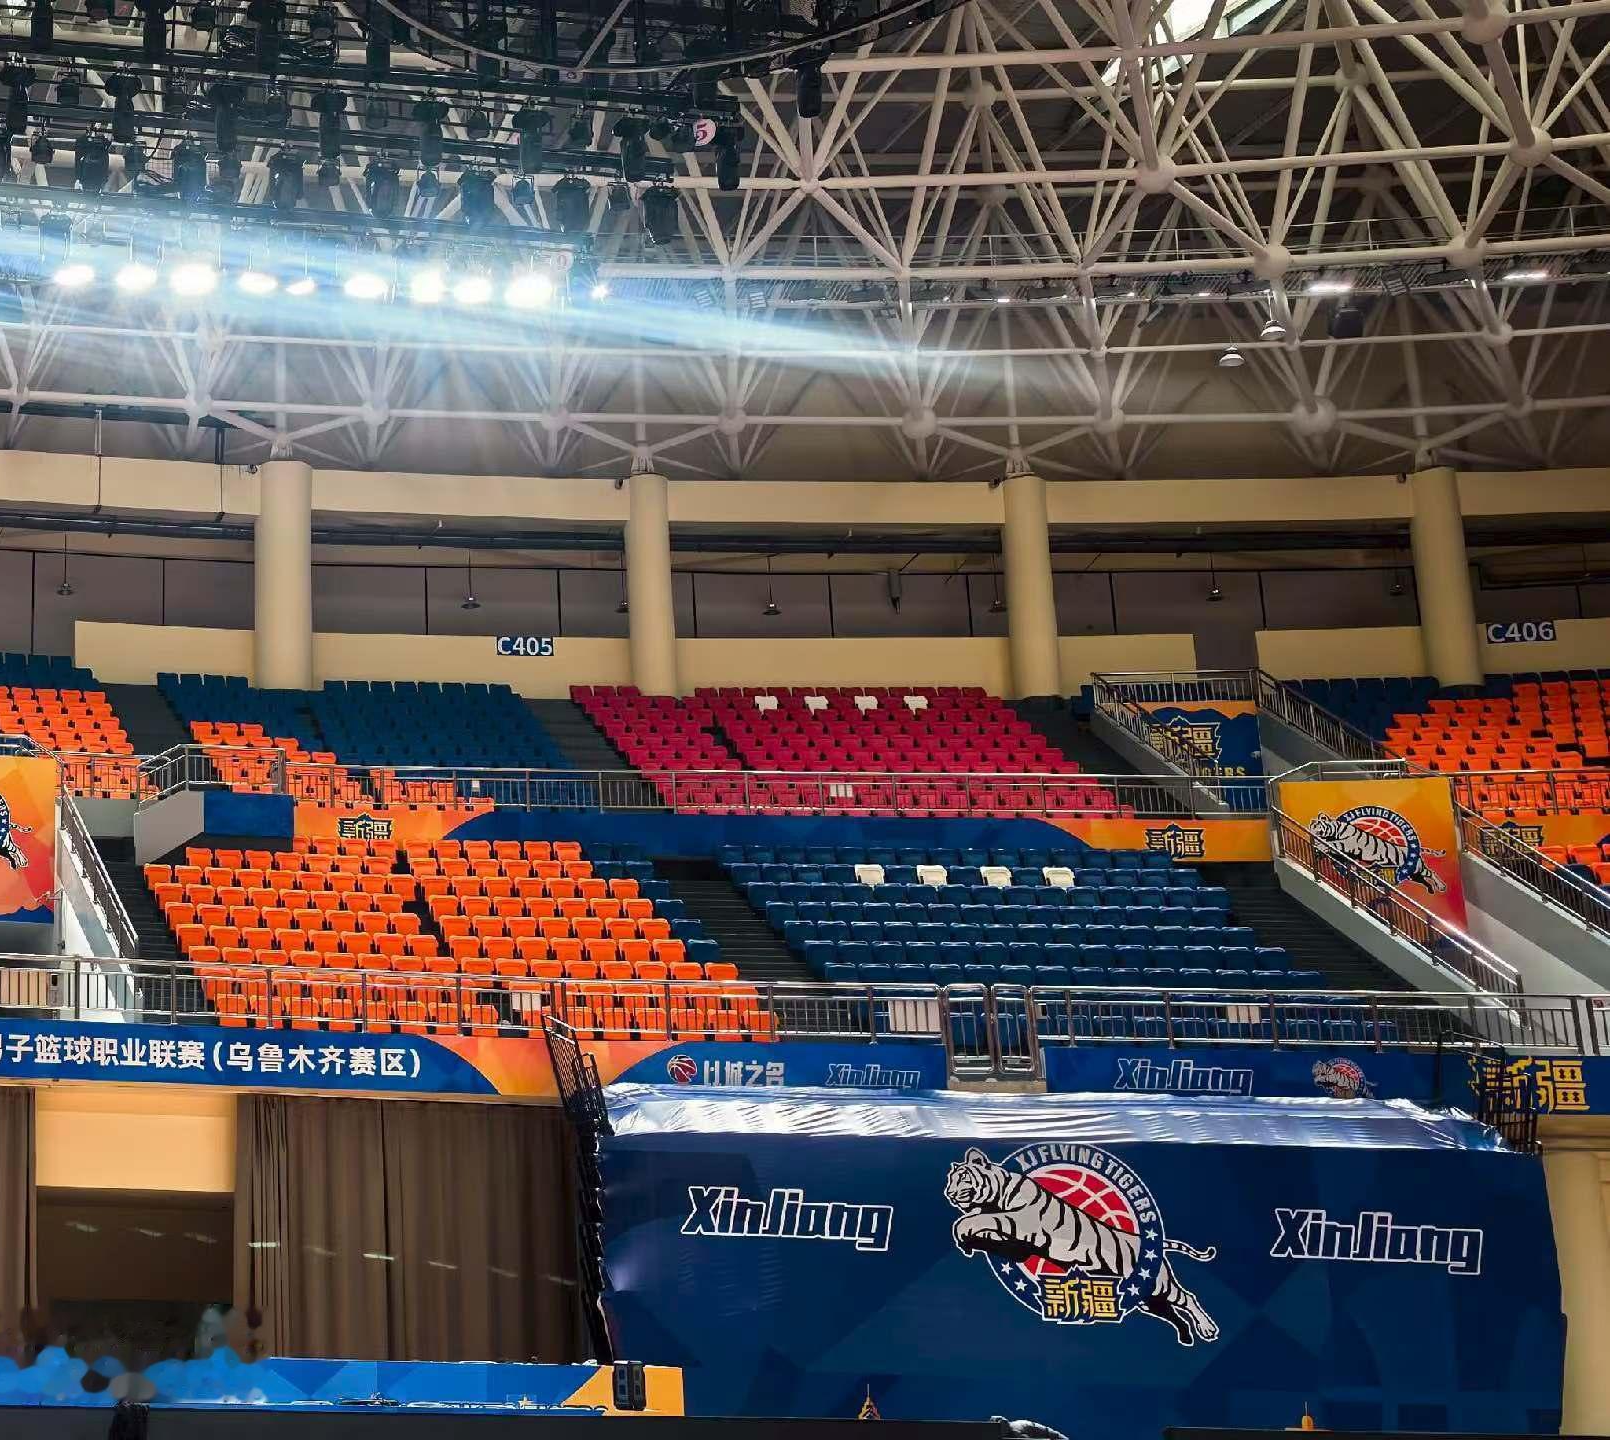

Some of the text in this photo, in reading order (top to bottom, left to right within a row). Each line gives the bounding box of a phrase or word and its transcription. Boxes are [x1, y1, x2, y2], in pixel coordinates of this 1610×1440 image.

[695, 122, 708, 141] 5
[497, 636, 553, 656] C405
[1487, 621, 1554, 642] C406
[703, 1060, 785, 1087] 以城之名
[824, 1063, 921, 1090] XinJiang
[1113, 1058, 1254, 1097] XinJiang
[1015, 1144, 1158, 1225] XJ FLYING TIGERS
[681, 1186, 894, 1252] XinJiang
[1270, 1208, 1483, 1275] XinJiang
[1043, 1276, 1120, 1319] 新疆
